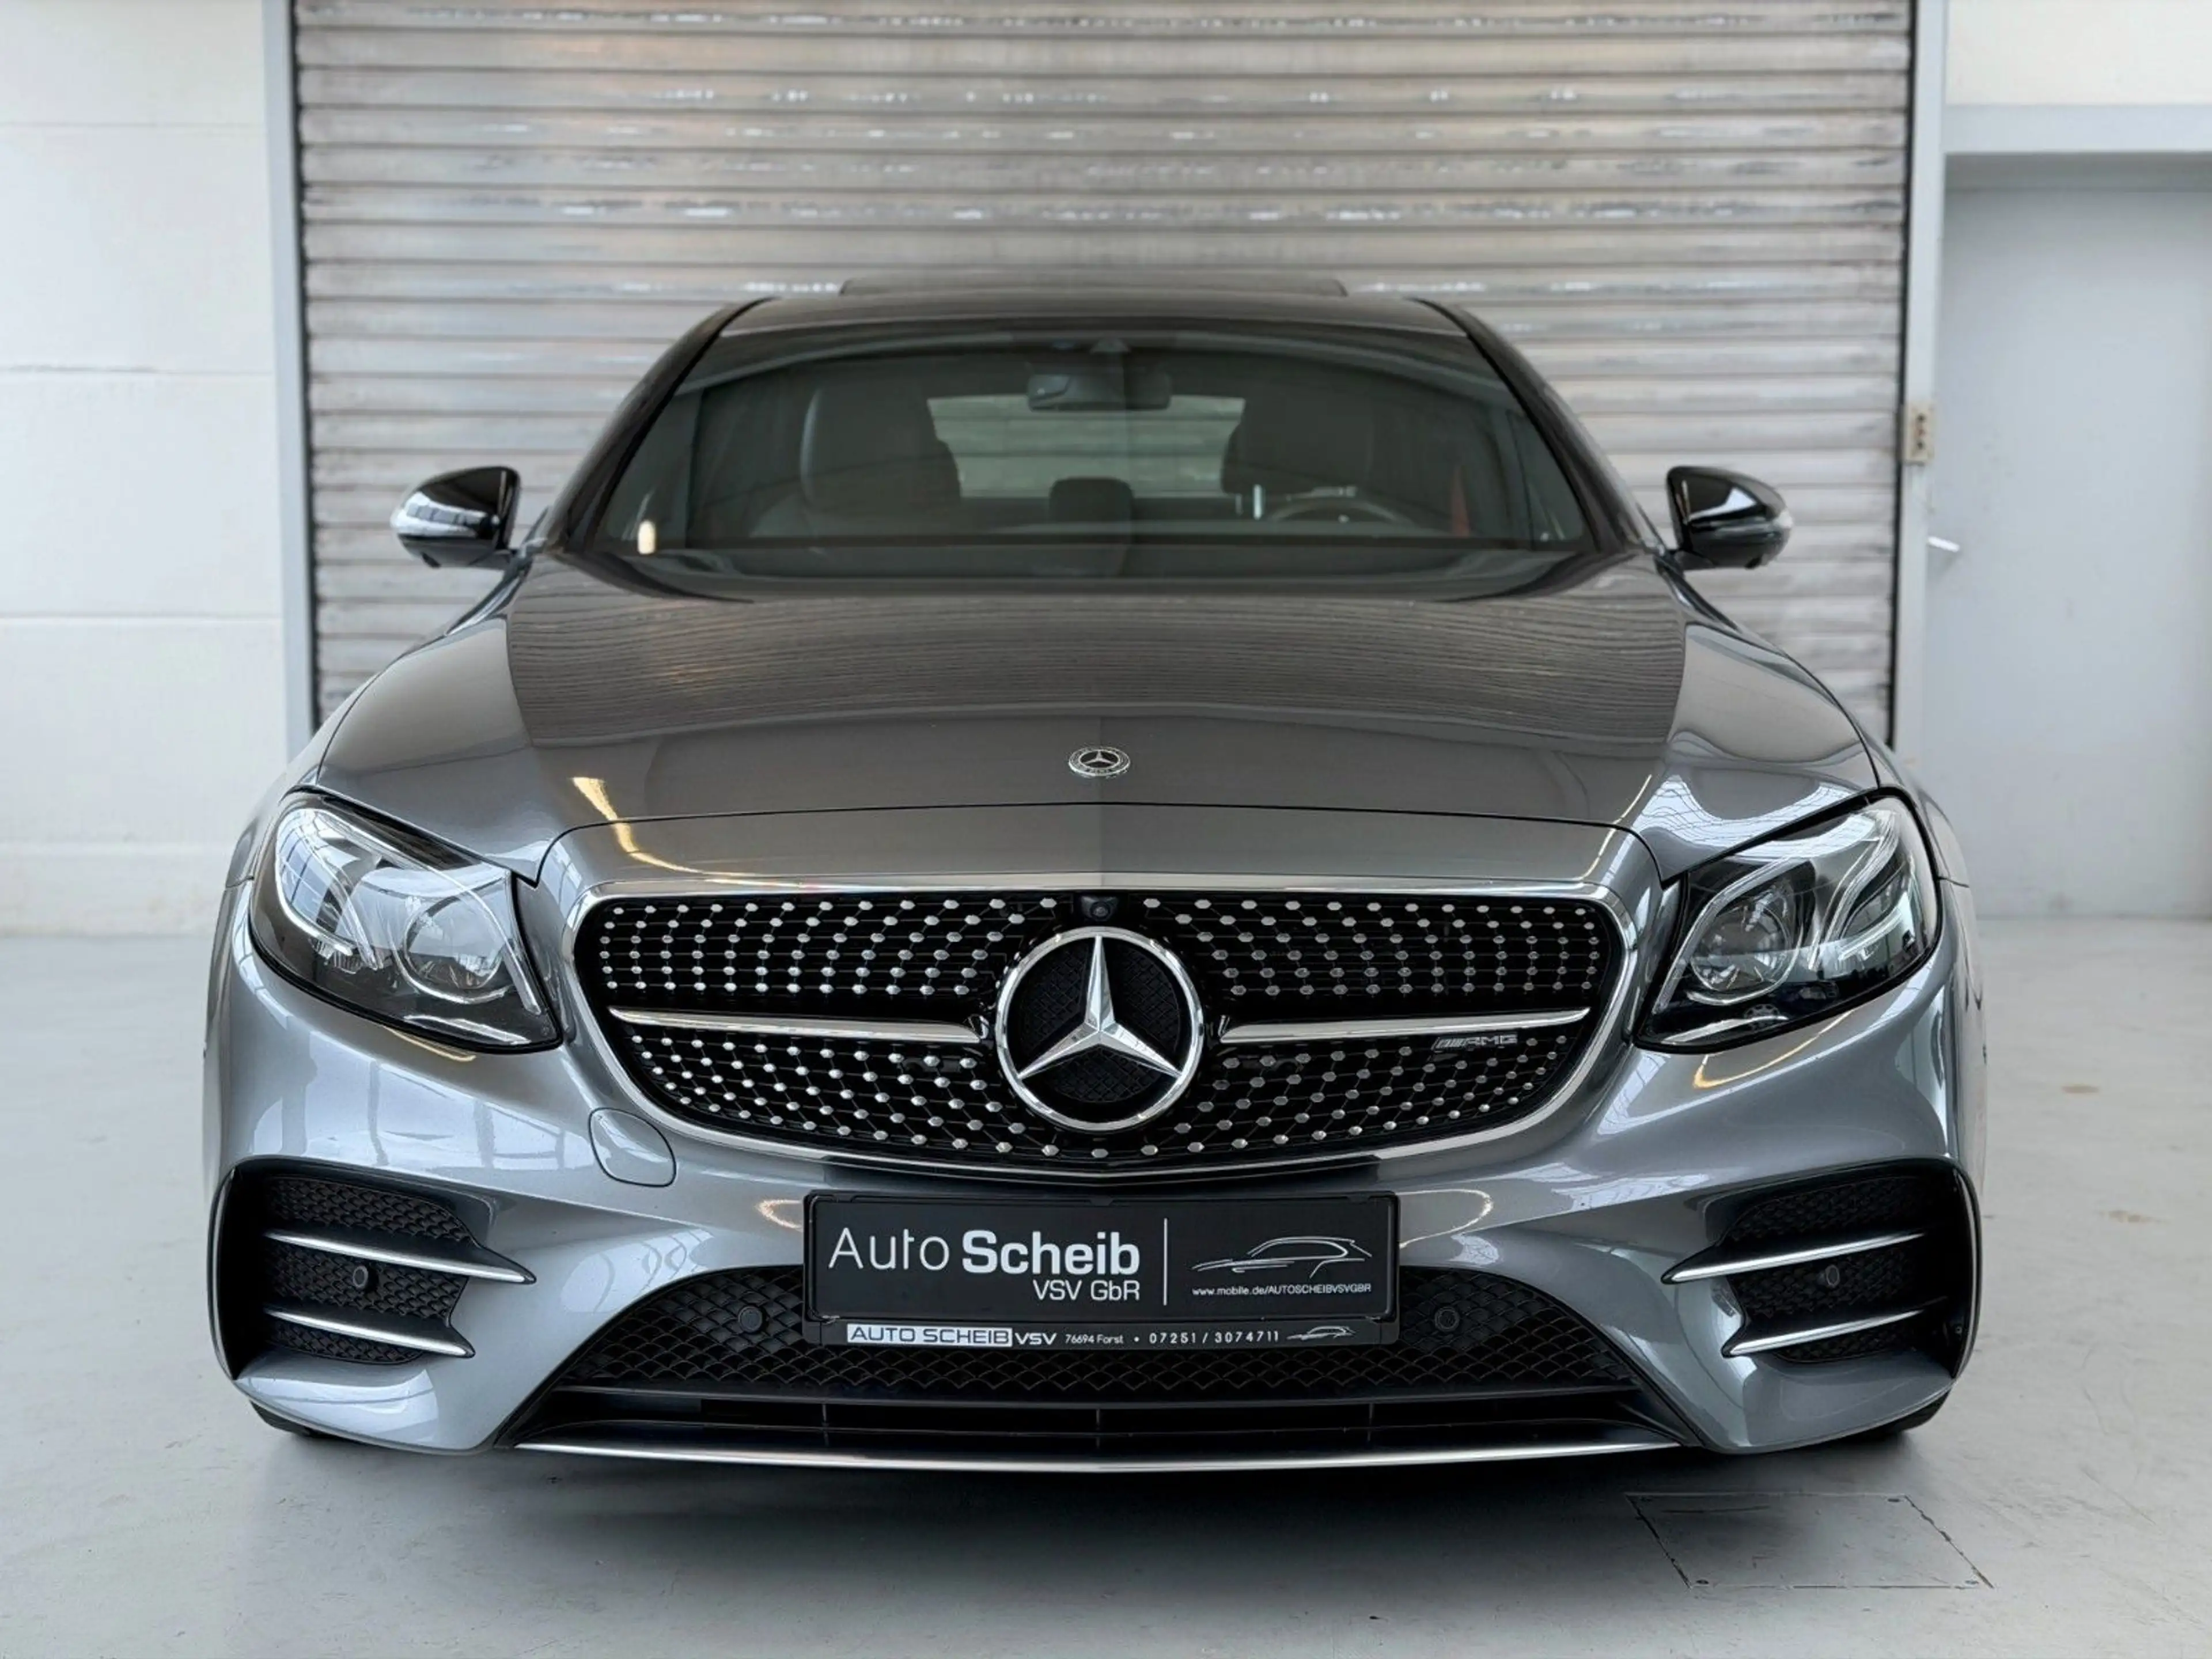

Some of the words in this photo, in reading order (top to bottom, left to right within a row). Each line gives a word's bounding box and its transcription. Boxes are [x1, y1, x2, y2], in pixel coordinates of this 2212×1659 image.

[828, 1227, 949, 1270] Auto
[961, 1230, 1140, 1275] Scheib
[1032, 1279, 1082, 1301] VSV
[1090, 1279, 1140, 1301] GbR
[1191, 1283, 1372, 1296] www.mobile.de/AUTOSCHEIBVSVGBR
[850, 1327, 916, 1342] AUTO
[923, 1328, 1009, 1344] SCHEIB
[1014, 1332, 1057, 1345] VSV
[1065, 1334, 1094, 1344] 76694
[1097, 1334, 1124, 1344] Forst
[1149, 1332, 1196, 1344] 07251
[1214, 1331, 1279, 1343] 3074711
